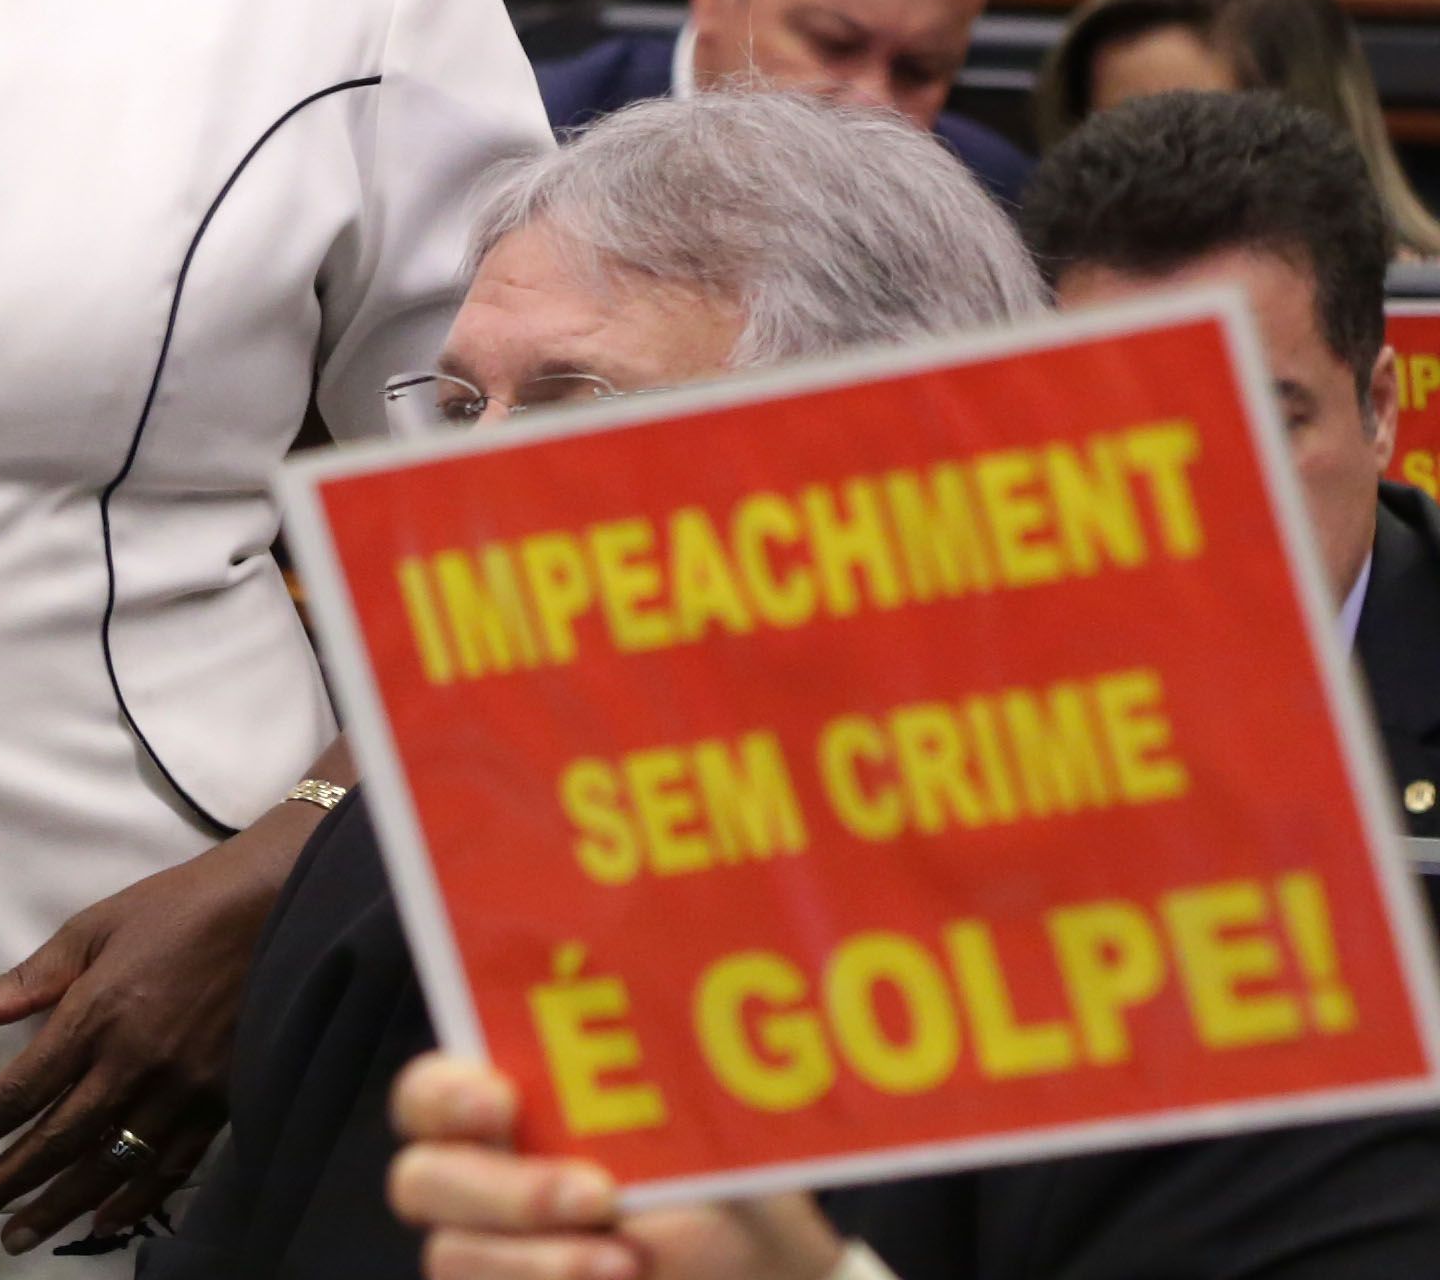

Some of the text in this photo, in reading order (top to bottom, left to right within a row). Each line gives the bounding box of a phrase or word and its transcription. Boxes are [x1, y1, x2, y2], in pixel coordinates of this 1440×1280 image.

[394, 419, 1205, 686] IMPEACHMENT
[558, 667, 1187, 886] SEM CRIME
[528, 869, 1357, 1138] É GOLPE!
